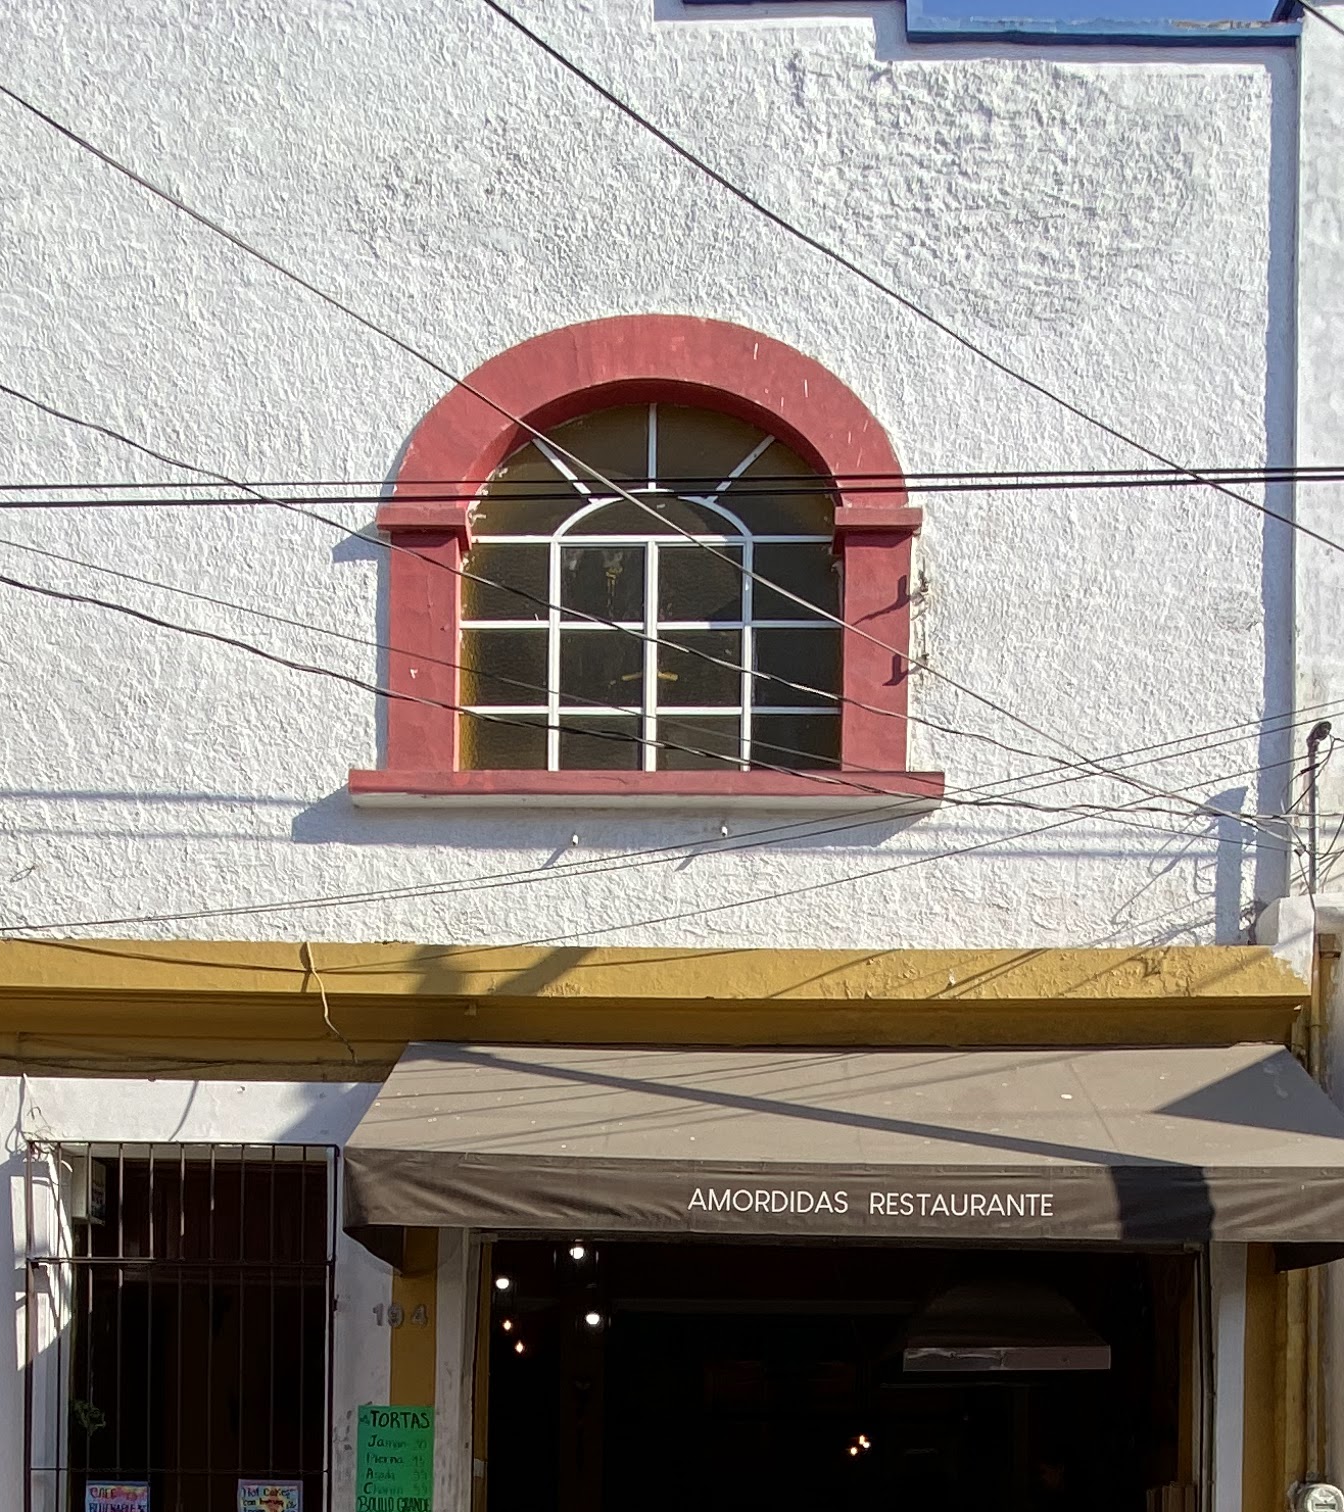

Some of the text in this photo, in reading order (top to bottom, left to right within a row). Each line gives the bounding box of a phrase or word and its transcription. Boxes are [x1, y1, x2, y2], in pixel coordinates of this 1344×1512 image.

[687, 1187, 1055, 1217] AMORDIDAS RESTAURANTE
[370, 1410, 430, 1429] TORTAS
